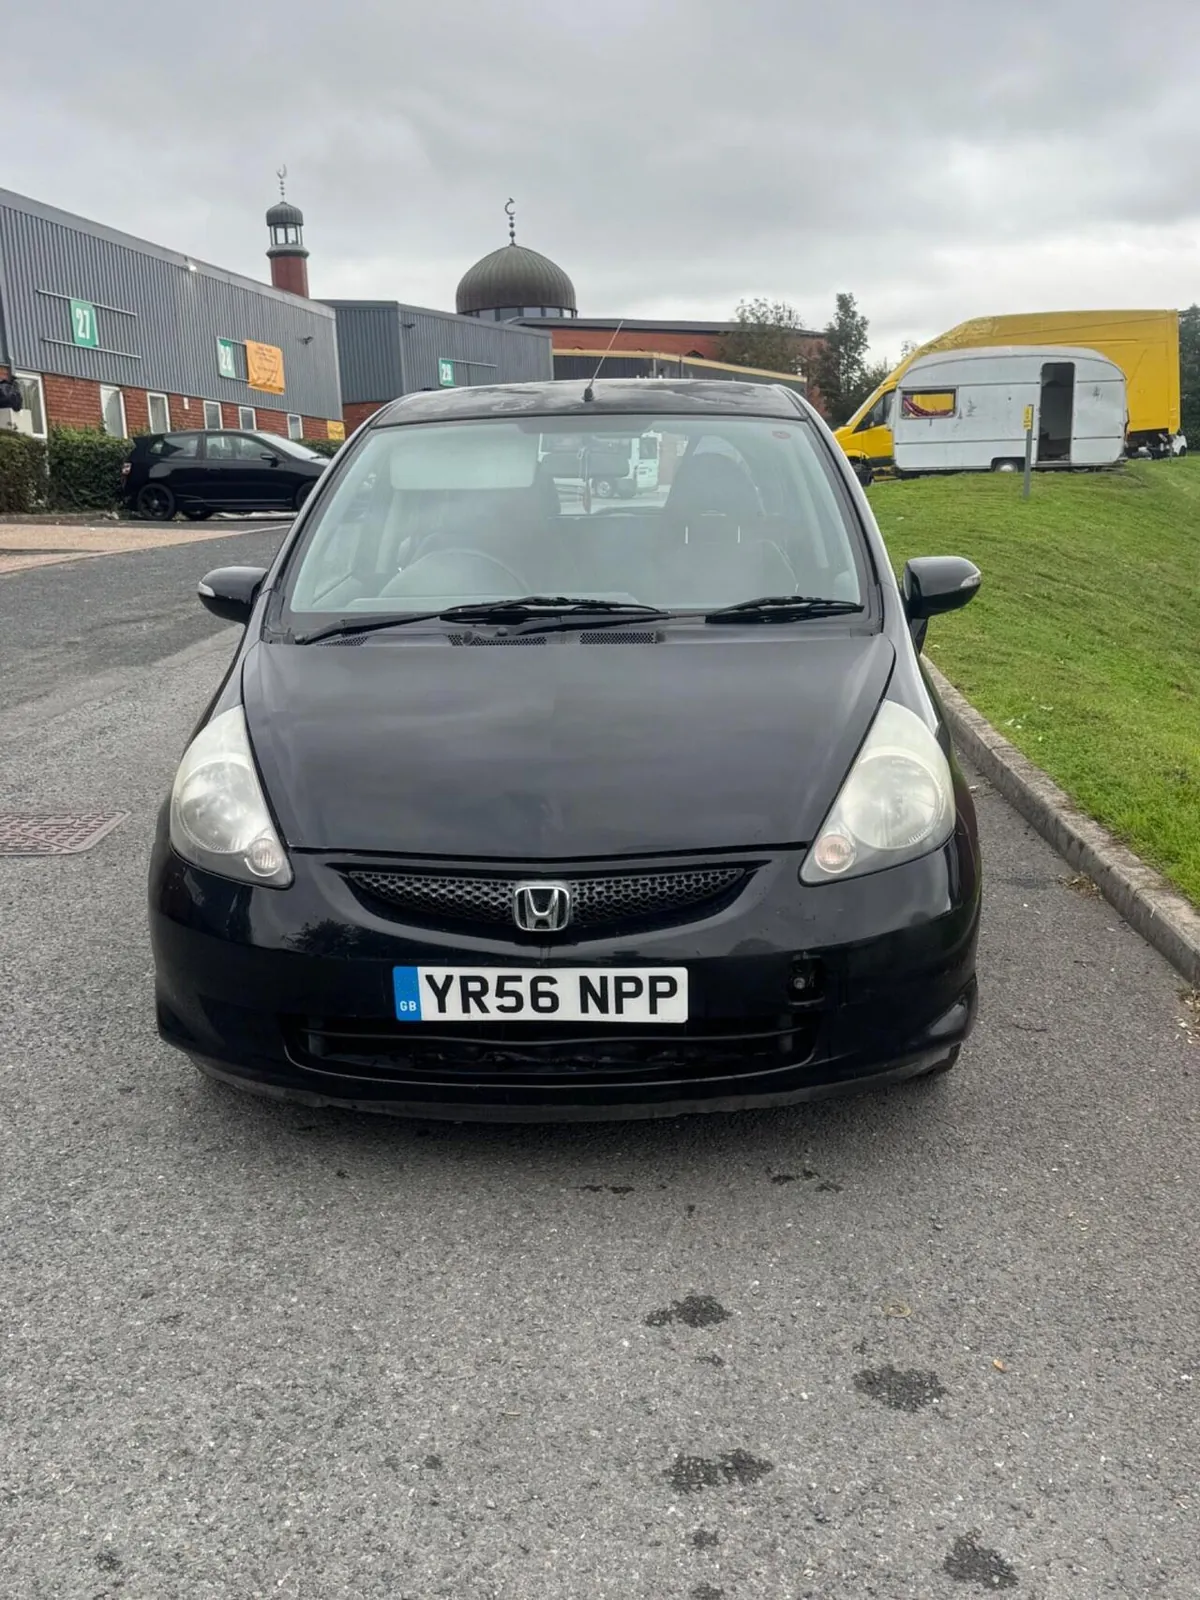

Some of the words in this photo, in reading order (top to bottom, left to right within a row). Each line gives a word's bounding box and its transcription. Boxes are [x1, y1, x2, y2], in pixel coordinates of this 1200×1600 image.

[75, 308, 91, 339] 27
[400, 1000, 417, 1012] GB
[425, 974, 560, 1014] YR56
[579, 975, 678, 1015] NPP
